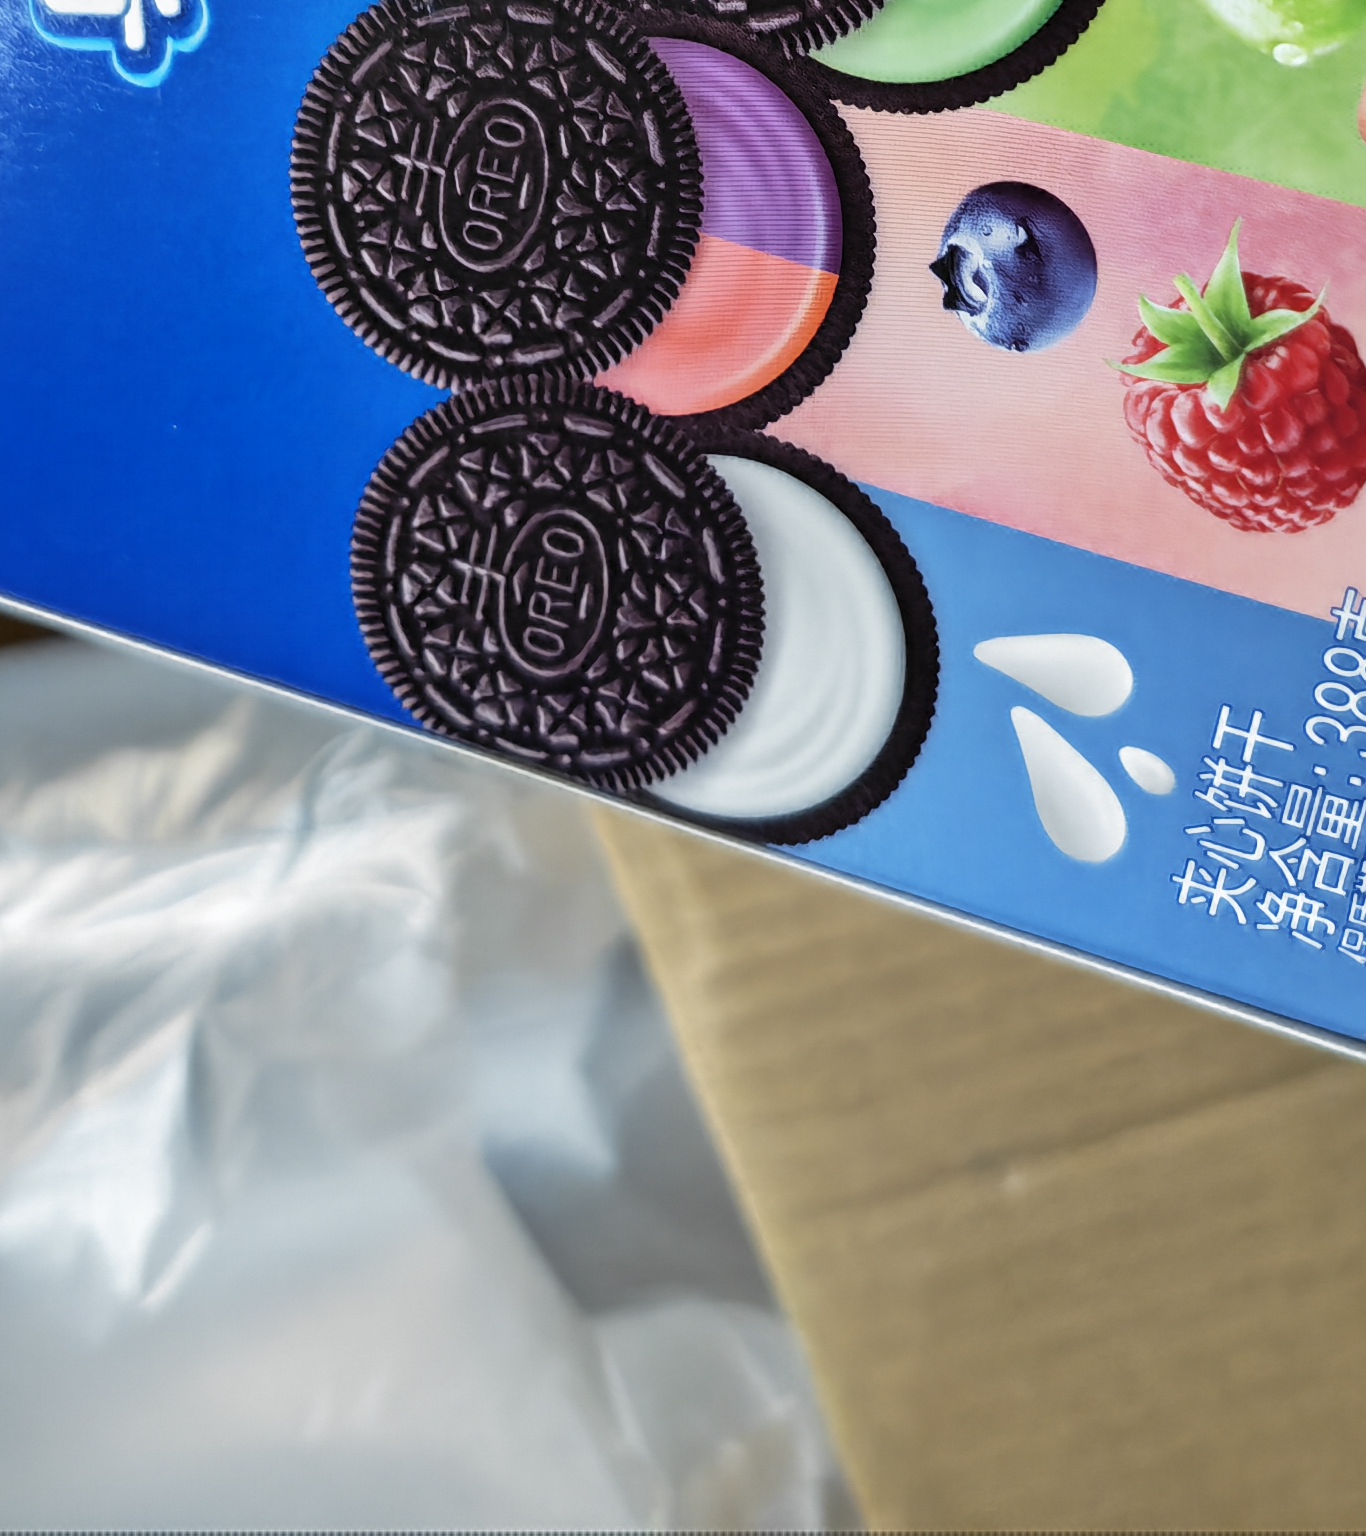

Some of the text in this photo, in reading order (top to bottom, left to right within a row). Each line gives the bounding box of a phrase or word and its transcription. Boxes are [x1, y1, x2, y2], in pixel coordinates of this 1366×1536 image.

[462, 116, 526, 250] OREO
[522, 527, 584, 656] OREO
[1171, 704, 1294, 926] 夹心饼干
